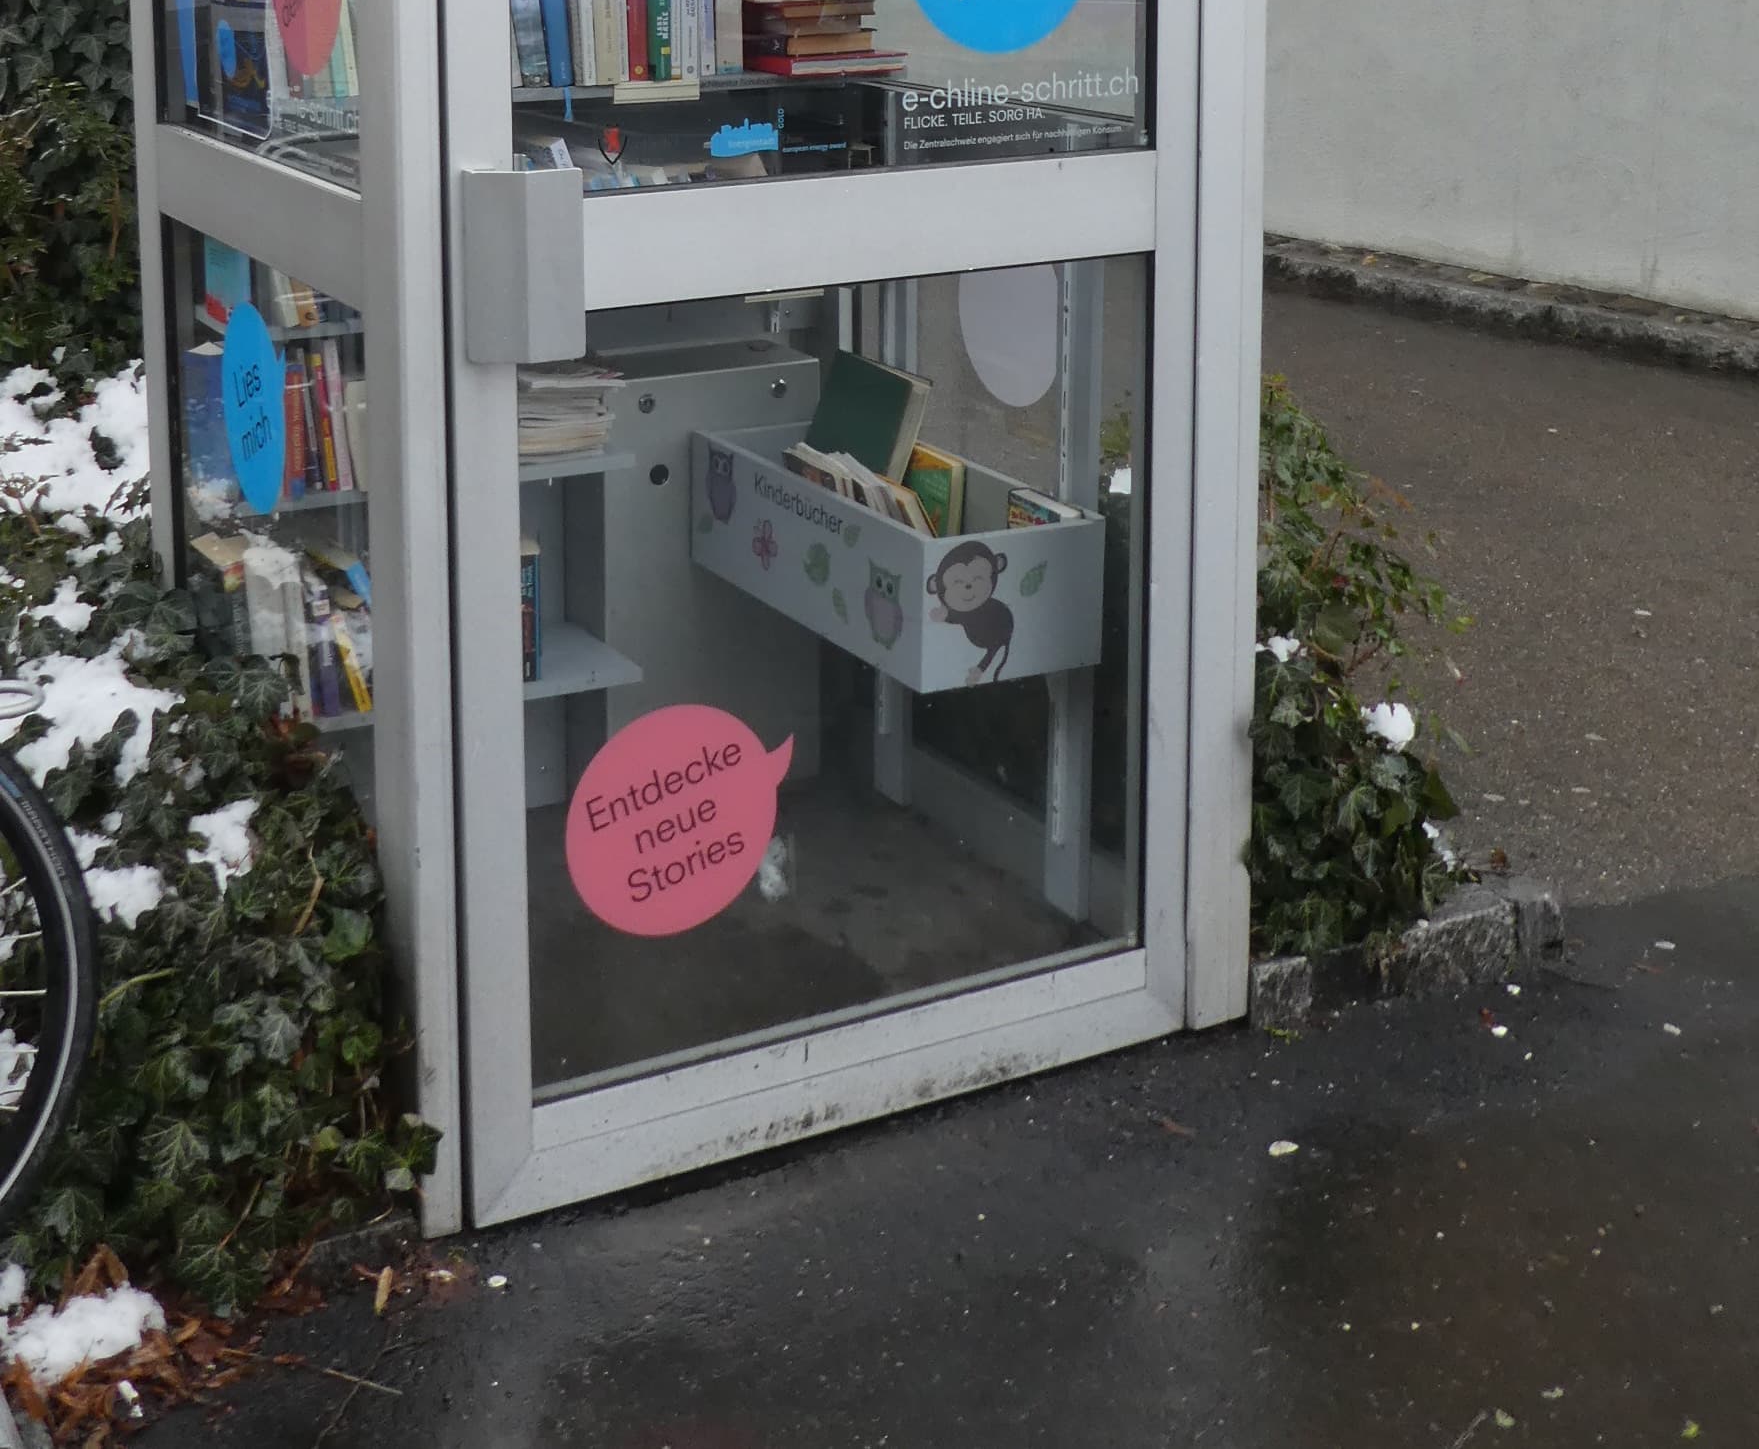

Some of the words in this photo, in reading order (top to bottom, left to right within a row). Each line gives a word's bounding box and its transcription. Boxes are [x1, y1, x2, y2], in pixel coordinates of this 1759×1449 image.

[901, 66, 1139, 112] e-chline-schritt.ch
[903, 115, 948, 130] FLICKE.
[951, 111, 986, 127] TEILE.
[988, 108, 1024, 123] SORG
[1026, 107, 1046, 121] HA.
[903, 140, 918, 150] Die
[1014, 130, 1031, 141] sich
[232, 363, 262, 408] Lies
[241, 405, 273, 462] mich
[753, 471, 843, 535] Kinderbücher
[585, 742, 742, 832] Entdecke
[634, 798, 717, 854] neue
[627, 831, 745, 903] Stories
